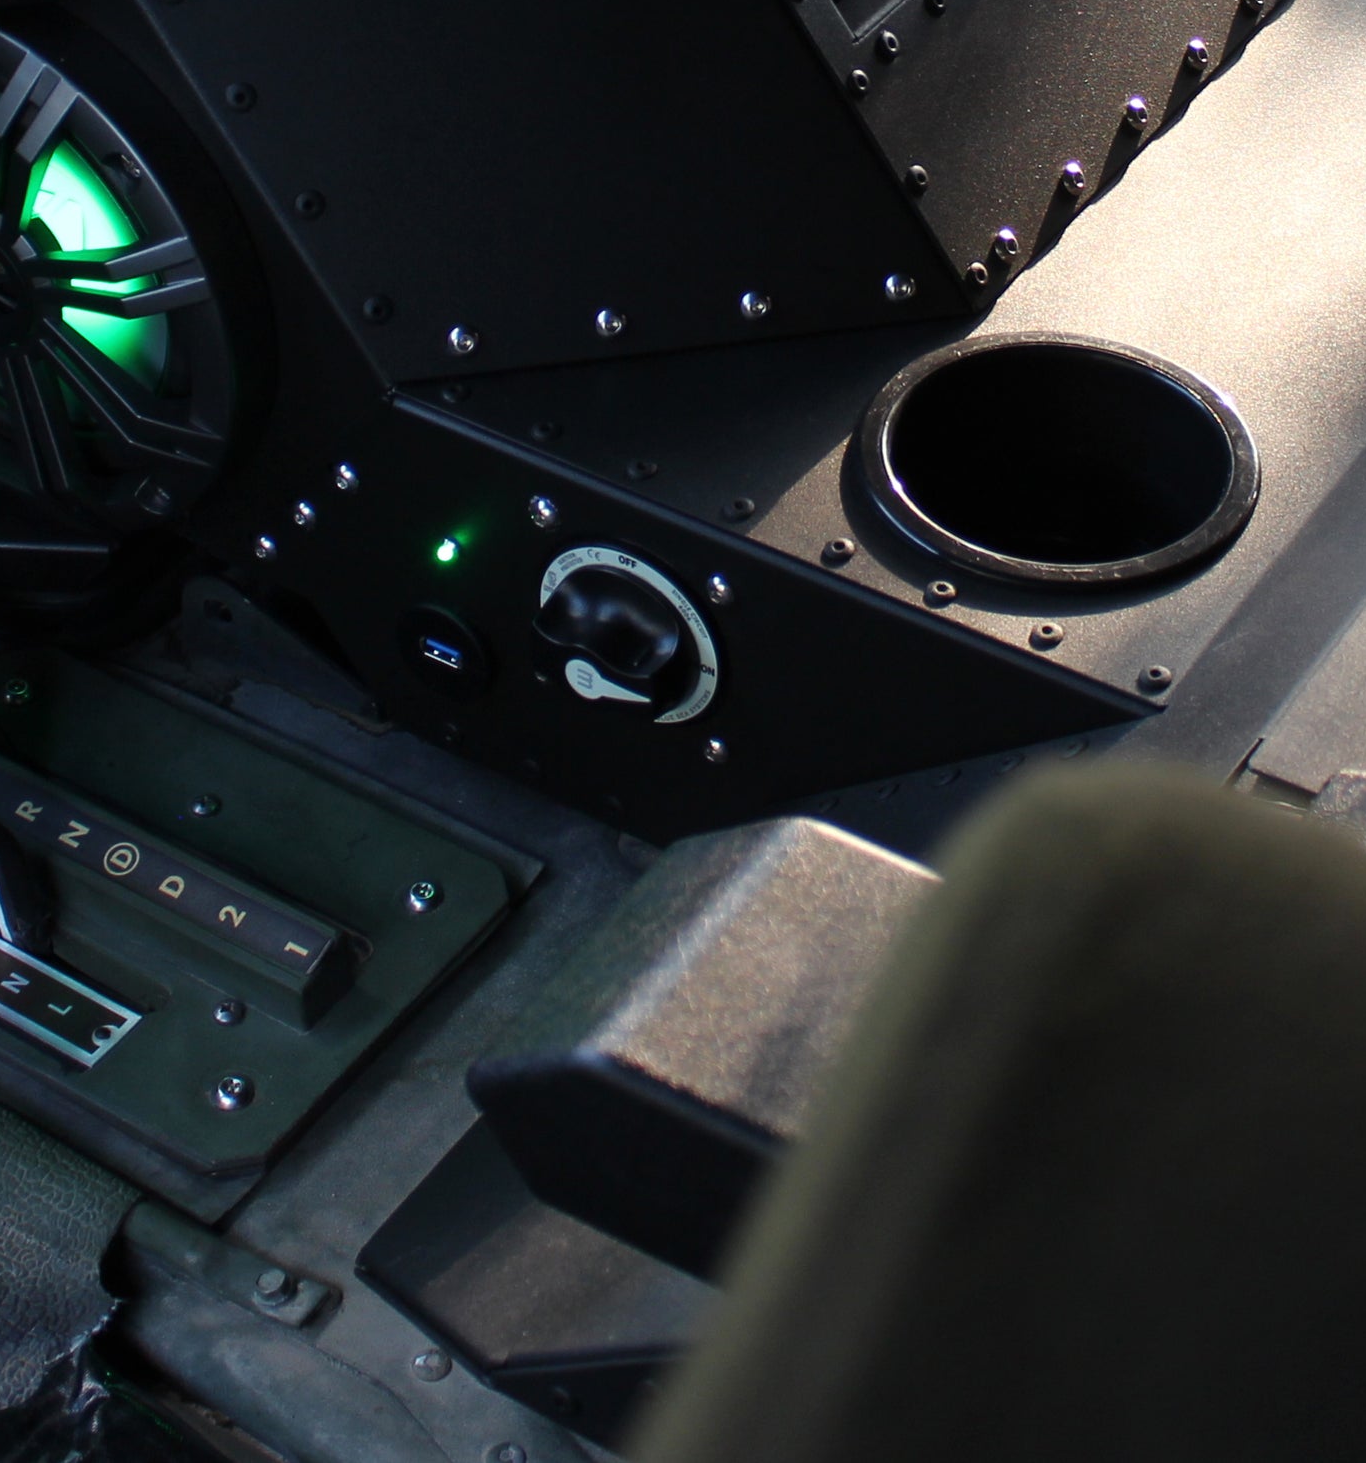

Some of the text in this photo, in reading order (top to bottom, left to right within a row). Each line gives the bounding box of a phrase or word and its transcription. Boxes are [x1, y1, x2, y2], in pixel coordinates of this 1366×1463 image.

[617, 554, 638, 570] OFF
[699, 663, 716, 678] ON
[15, 800, 43, 823] R
[58, 819, 91, 848] N
[158, 873, 186, 900] D
[218, 904, 247, 929] 2
[284, 940, 310, 957] 1
[0, 972, 32, 995] N
[47, 1001, 73, 1017] L
